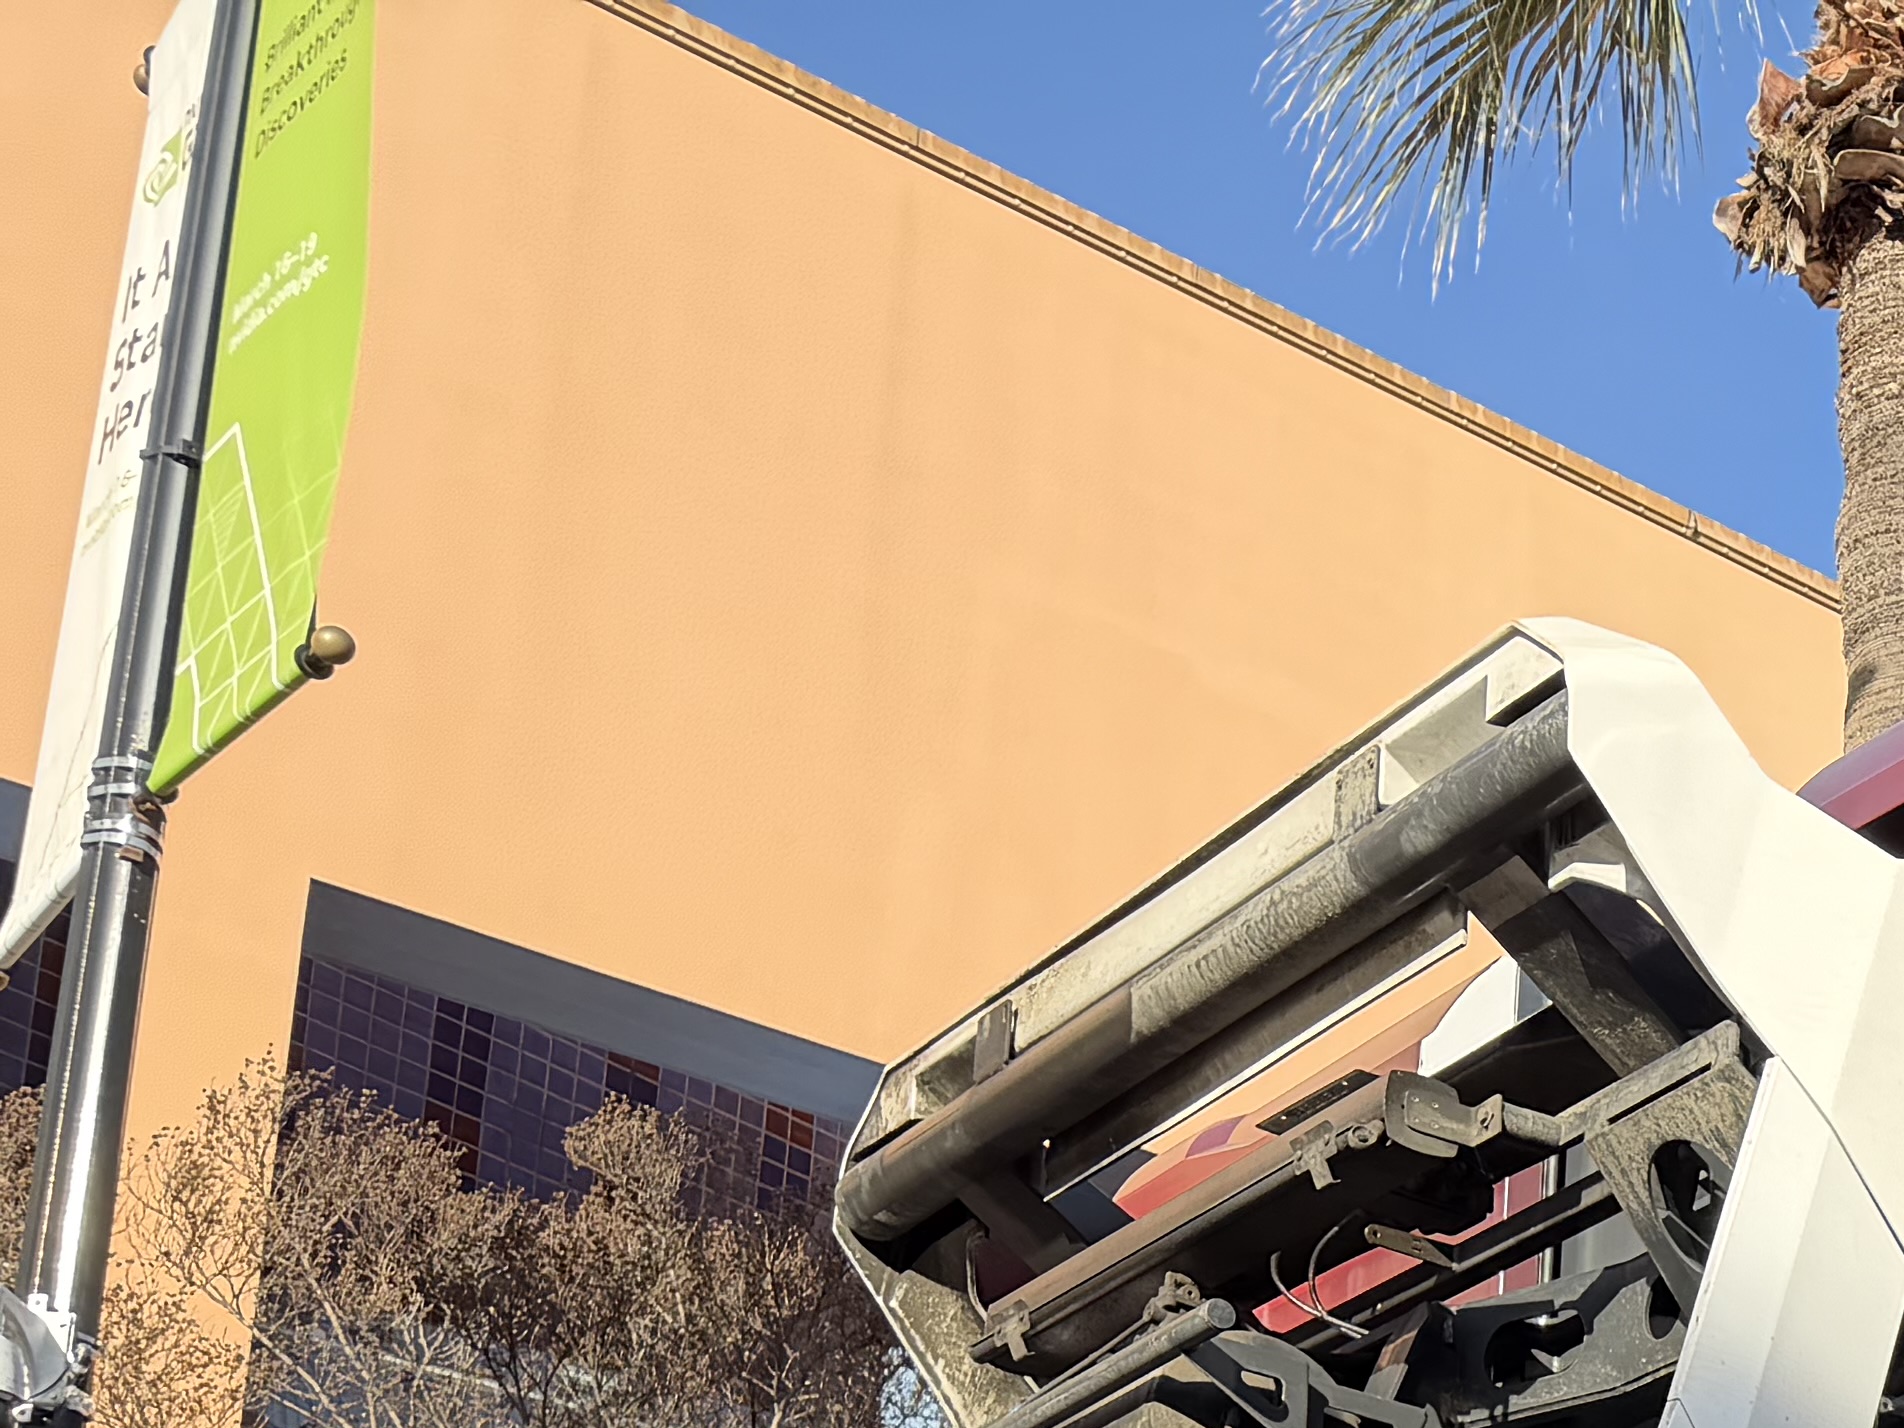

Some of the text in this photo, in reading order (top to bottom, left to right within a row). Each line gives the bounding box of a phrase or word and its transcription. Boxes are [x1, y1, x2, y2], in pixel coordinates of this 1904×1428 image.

[260, 0, 360, 117] Breakthroug
[255, 48, 347, 159] Discoveries
[122, 267, 146, 324] It
[109, 321, 160, 393] Sta
[97, 388, 152, 465] Her
